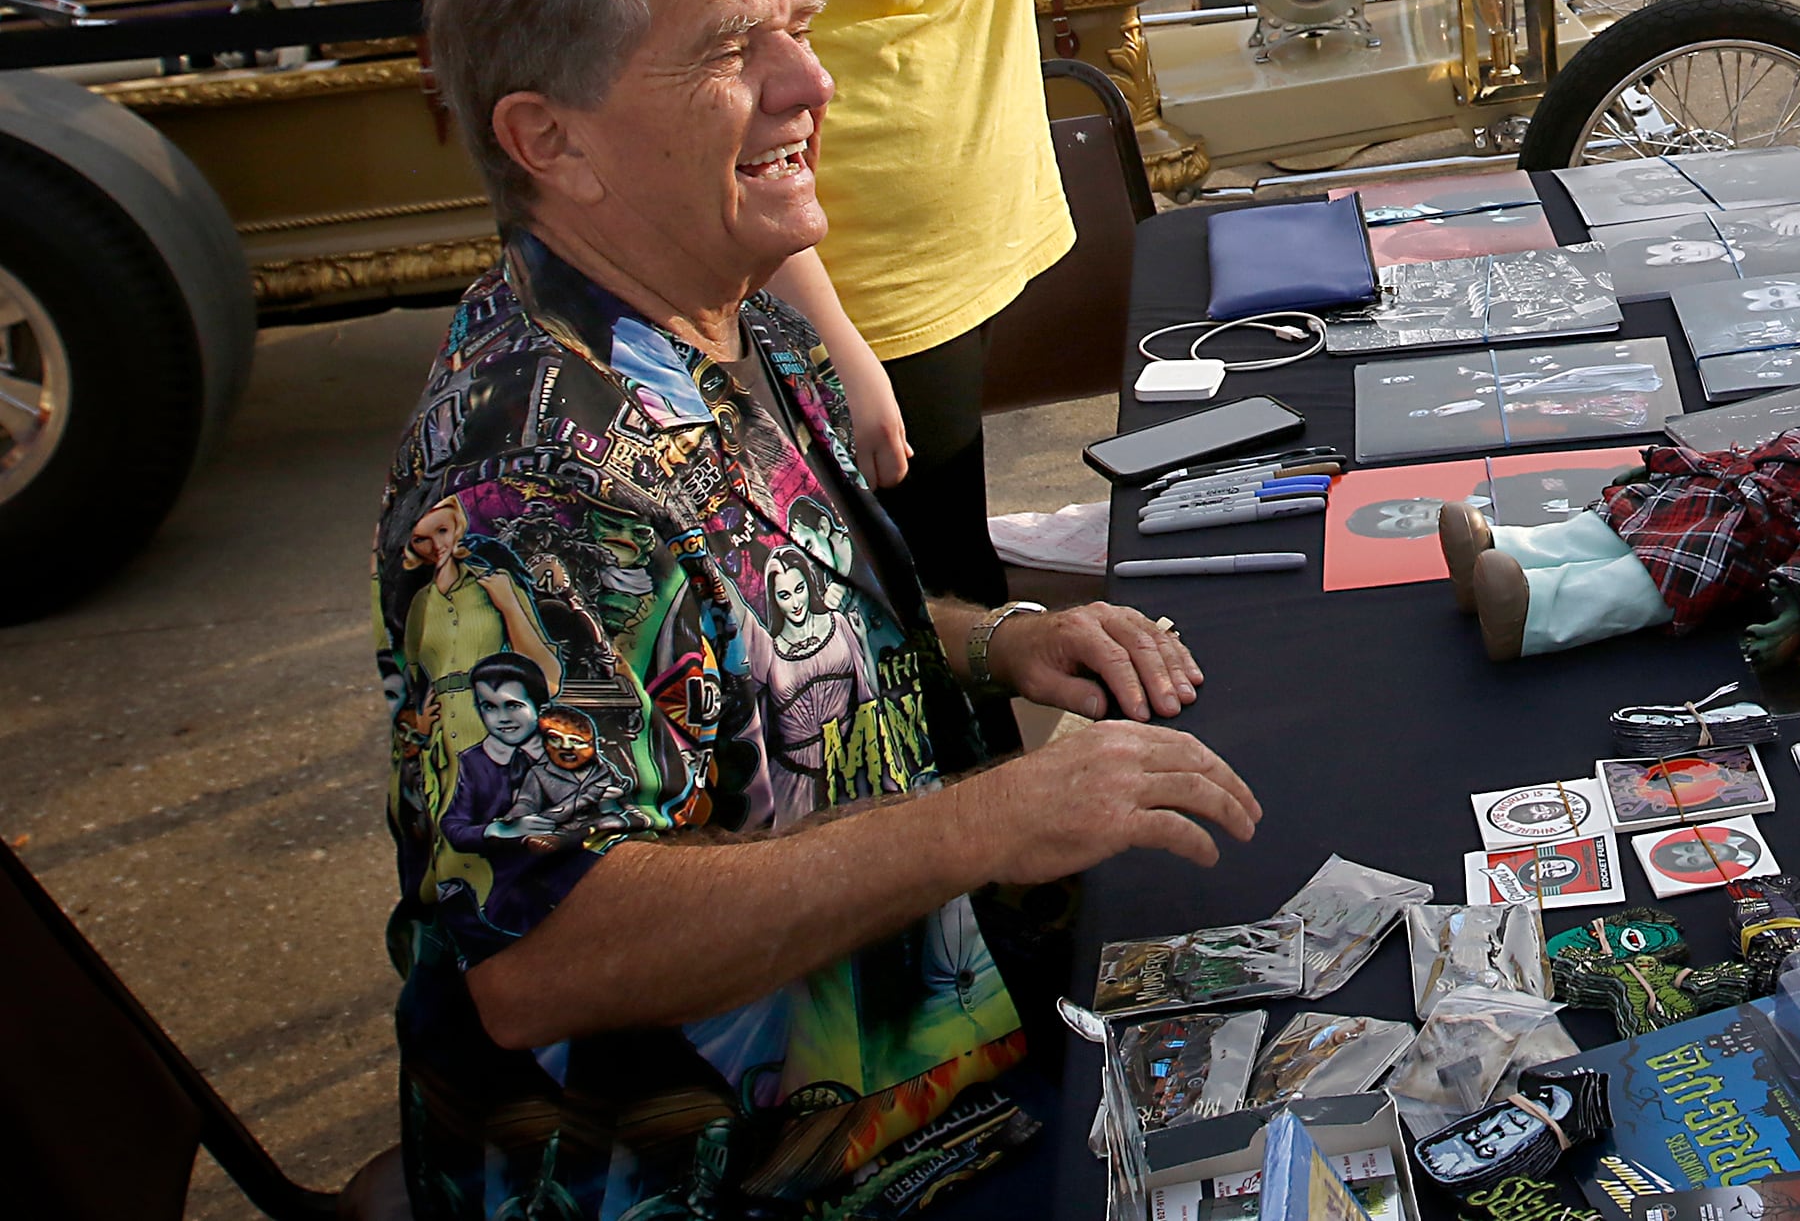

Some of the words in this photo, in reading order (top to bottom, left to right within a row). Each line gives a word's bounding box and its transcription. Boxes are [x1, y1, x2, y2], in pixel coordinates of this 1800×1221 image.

[1500, 793, 1530, 814] WORLD
[1492, 812, 1505, 824] THE
[1501, 822, 1514, 830] IN
[1517, 826, 1558, 835] WHERE
[1596, 838, 1606, 859] FUEL
[1598, 860, 1611, 888] ROCKET
[1136, 951, 1170, 1001] MUNSTERS
[1665, 1132, 1711, 1183] MUNSTERS
